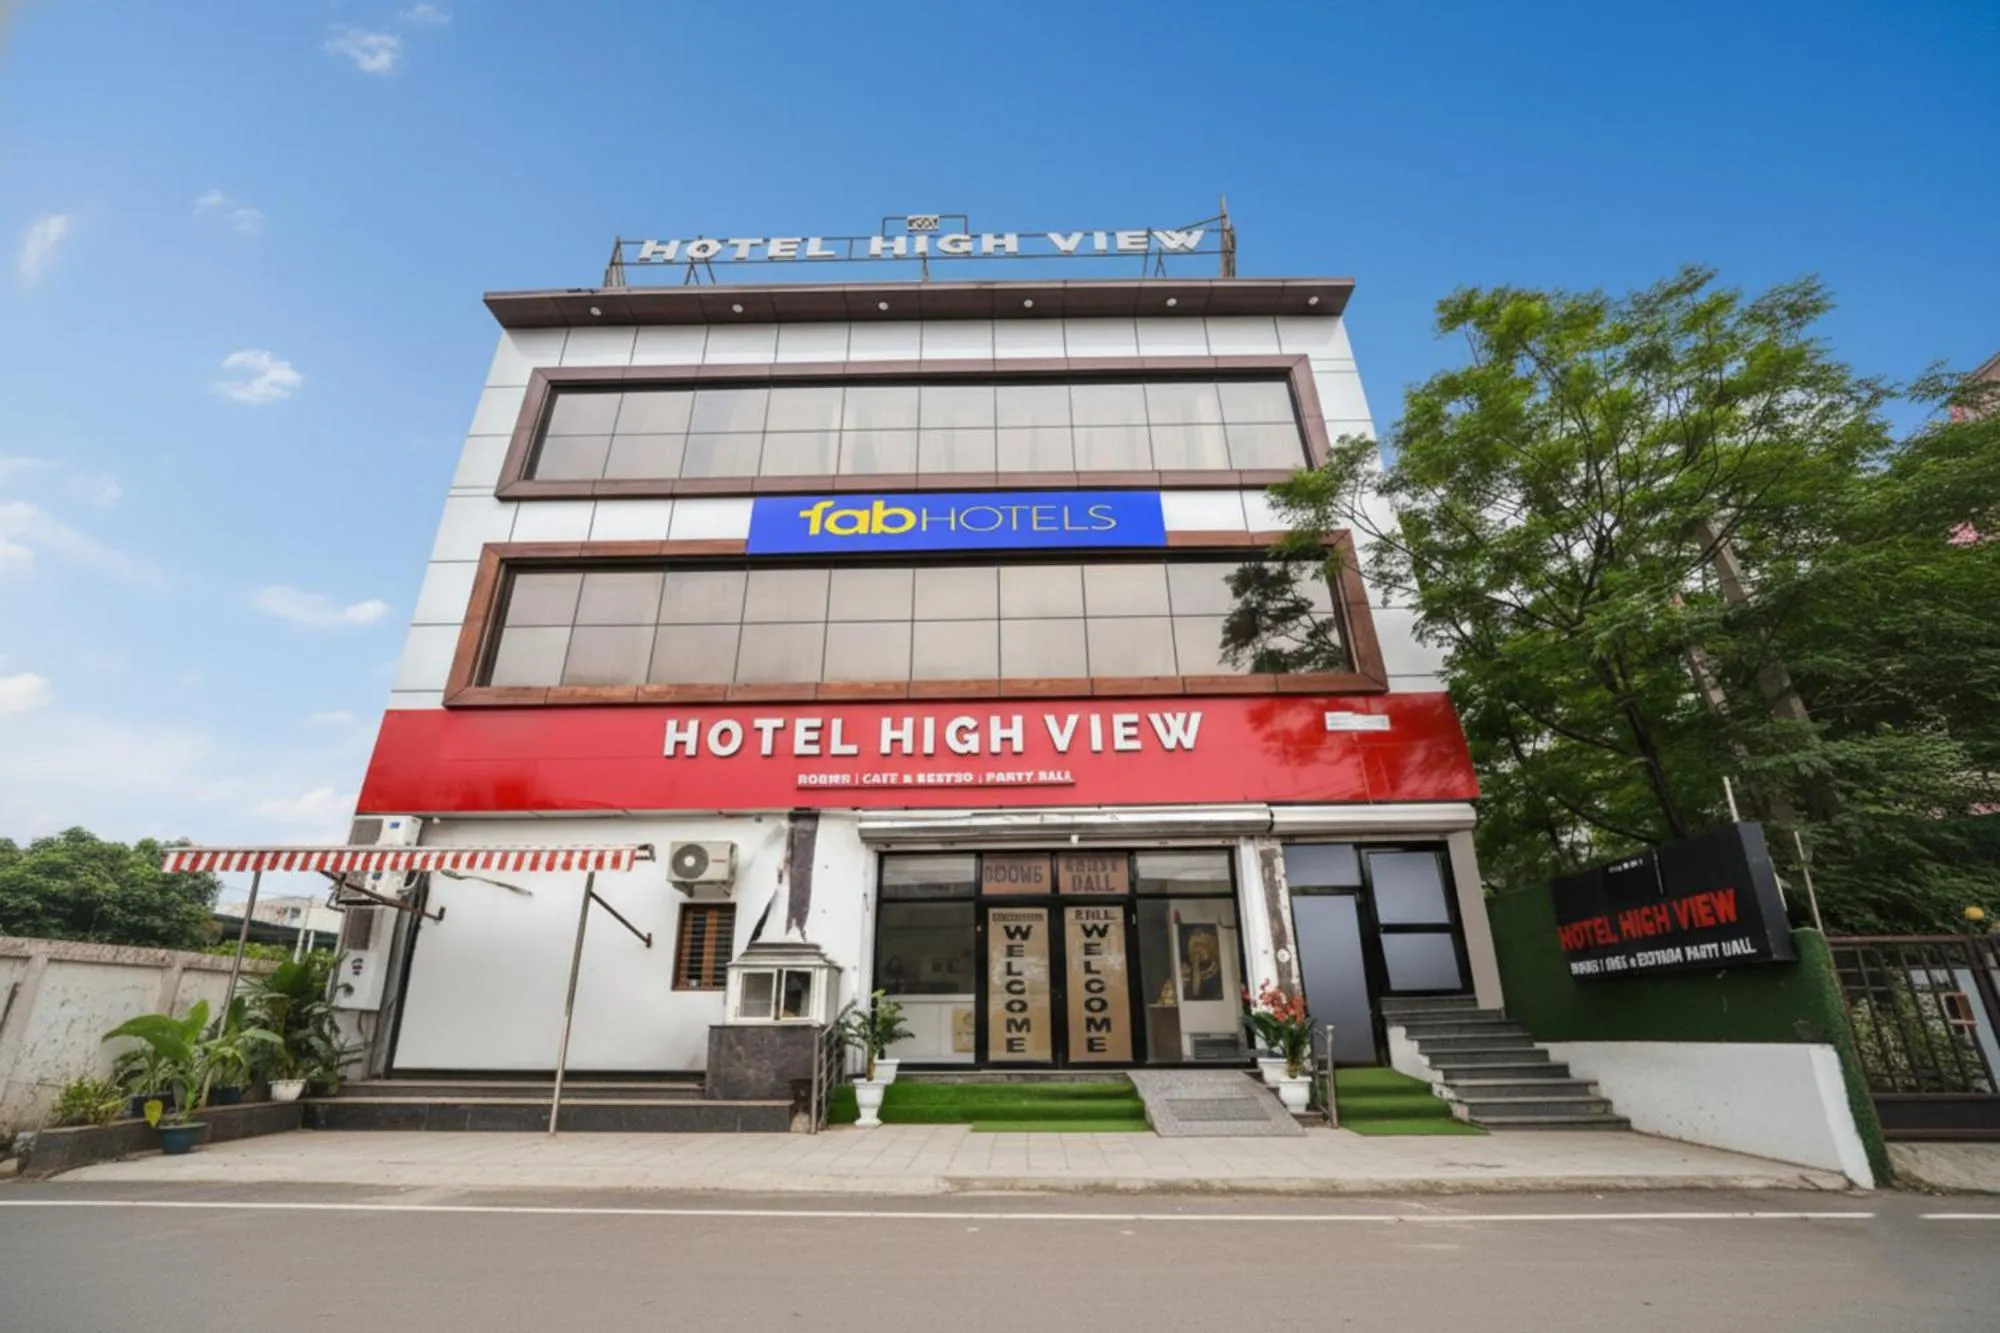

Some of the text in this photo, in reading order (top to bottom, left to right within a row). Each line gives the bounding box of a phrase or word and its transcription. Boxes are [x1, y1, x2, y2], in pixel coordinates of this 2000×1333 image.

[637, 228, 1204, 262] HOTEL HIGH VIEW
[662, 711, 1202, 757] HOTEL HIGH VIEW
[1558, 887, 1738, 949] HOTEL HIGH VIEW
[1003, 925, 1033, 1053] WELCOME
[1081, 923, 1112, 1053] WELCOME
